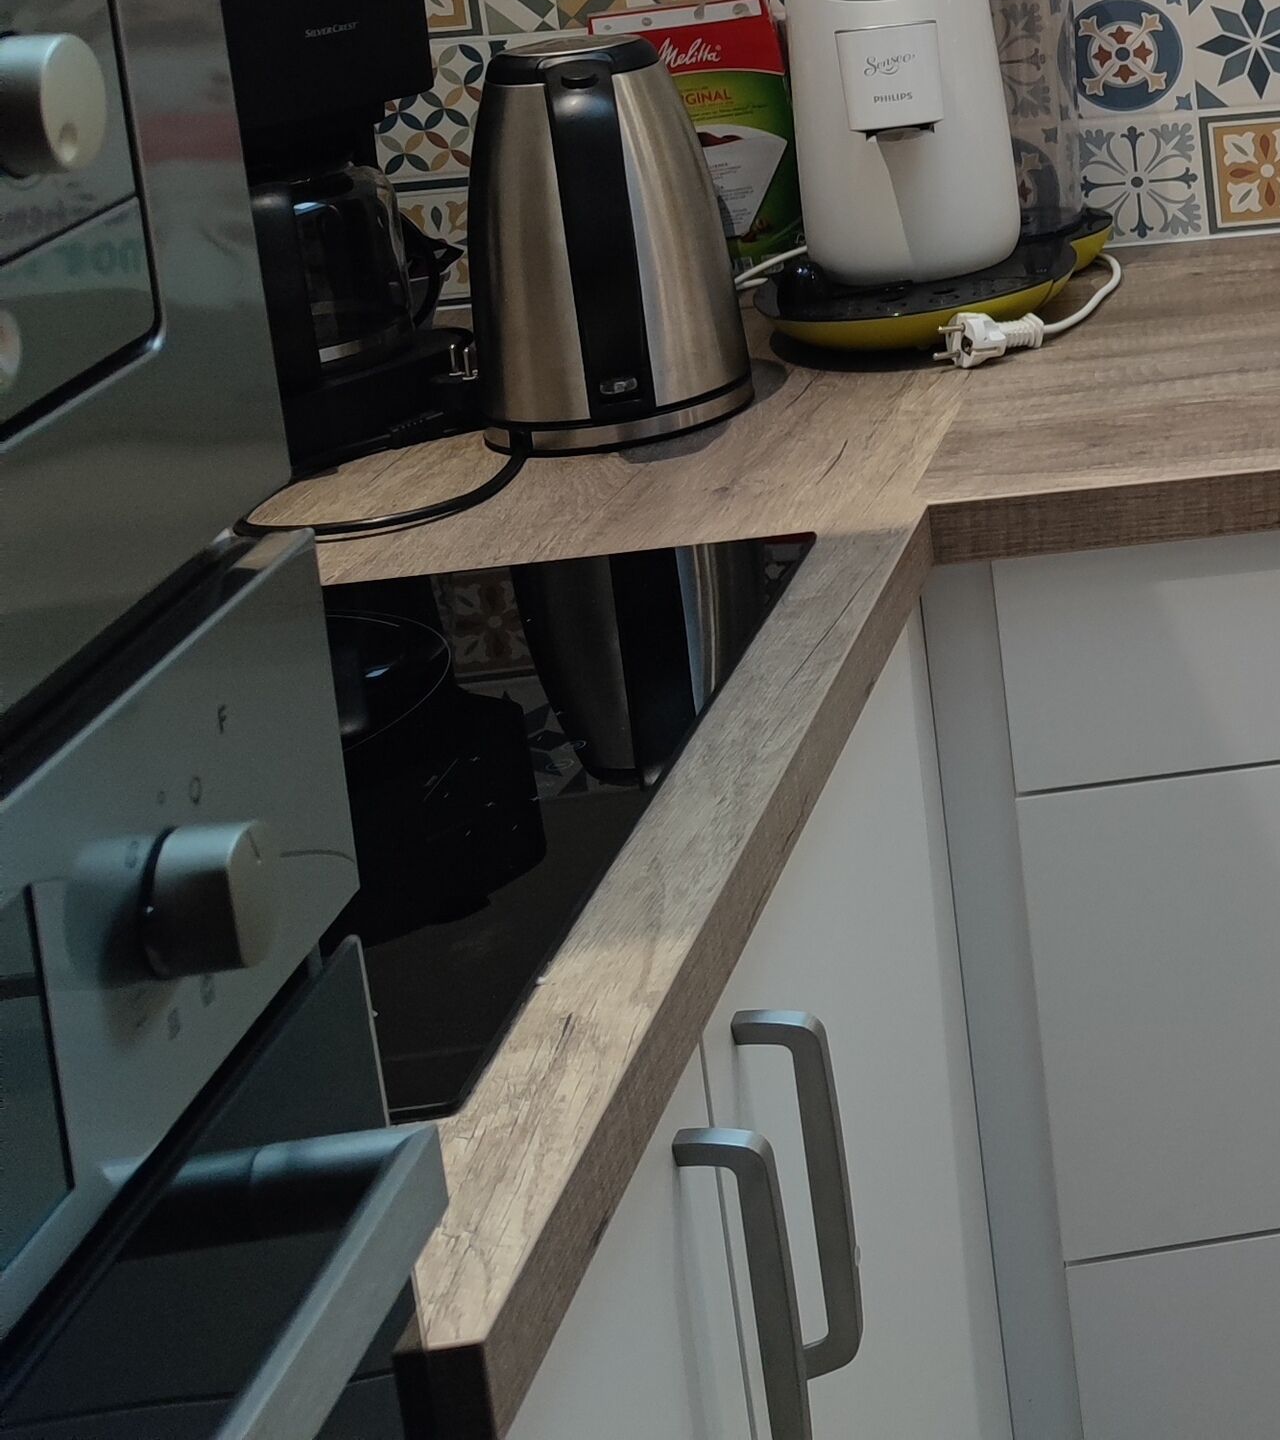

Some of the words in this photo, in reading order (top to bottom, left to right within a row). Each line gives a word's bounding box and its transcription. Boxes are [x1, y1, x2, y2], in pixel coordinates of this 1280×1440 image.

[658, 37, 720, 68] Melitta
[681, 89, 732, 105] GINAL
[873, 91, 913, 104] PHILIPS
